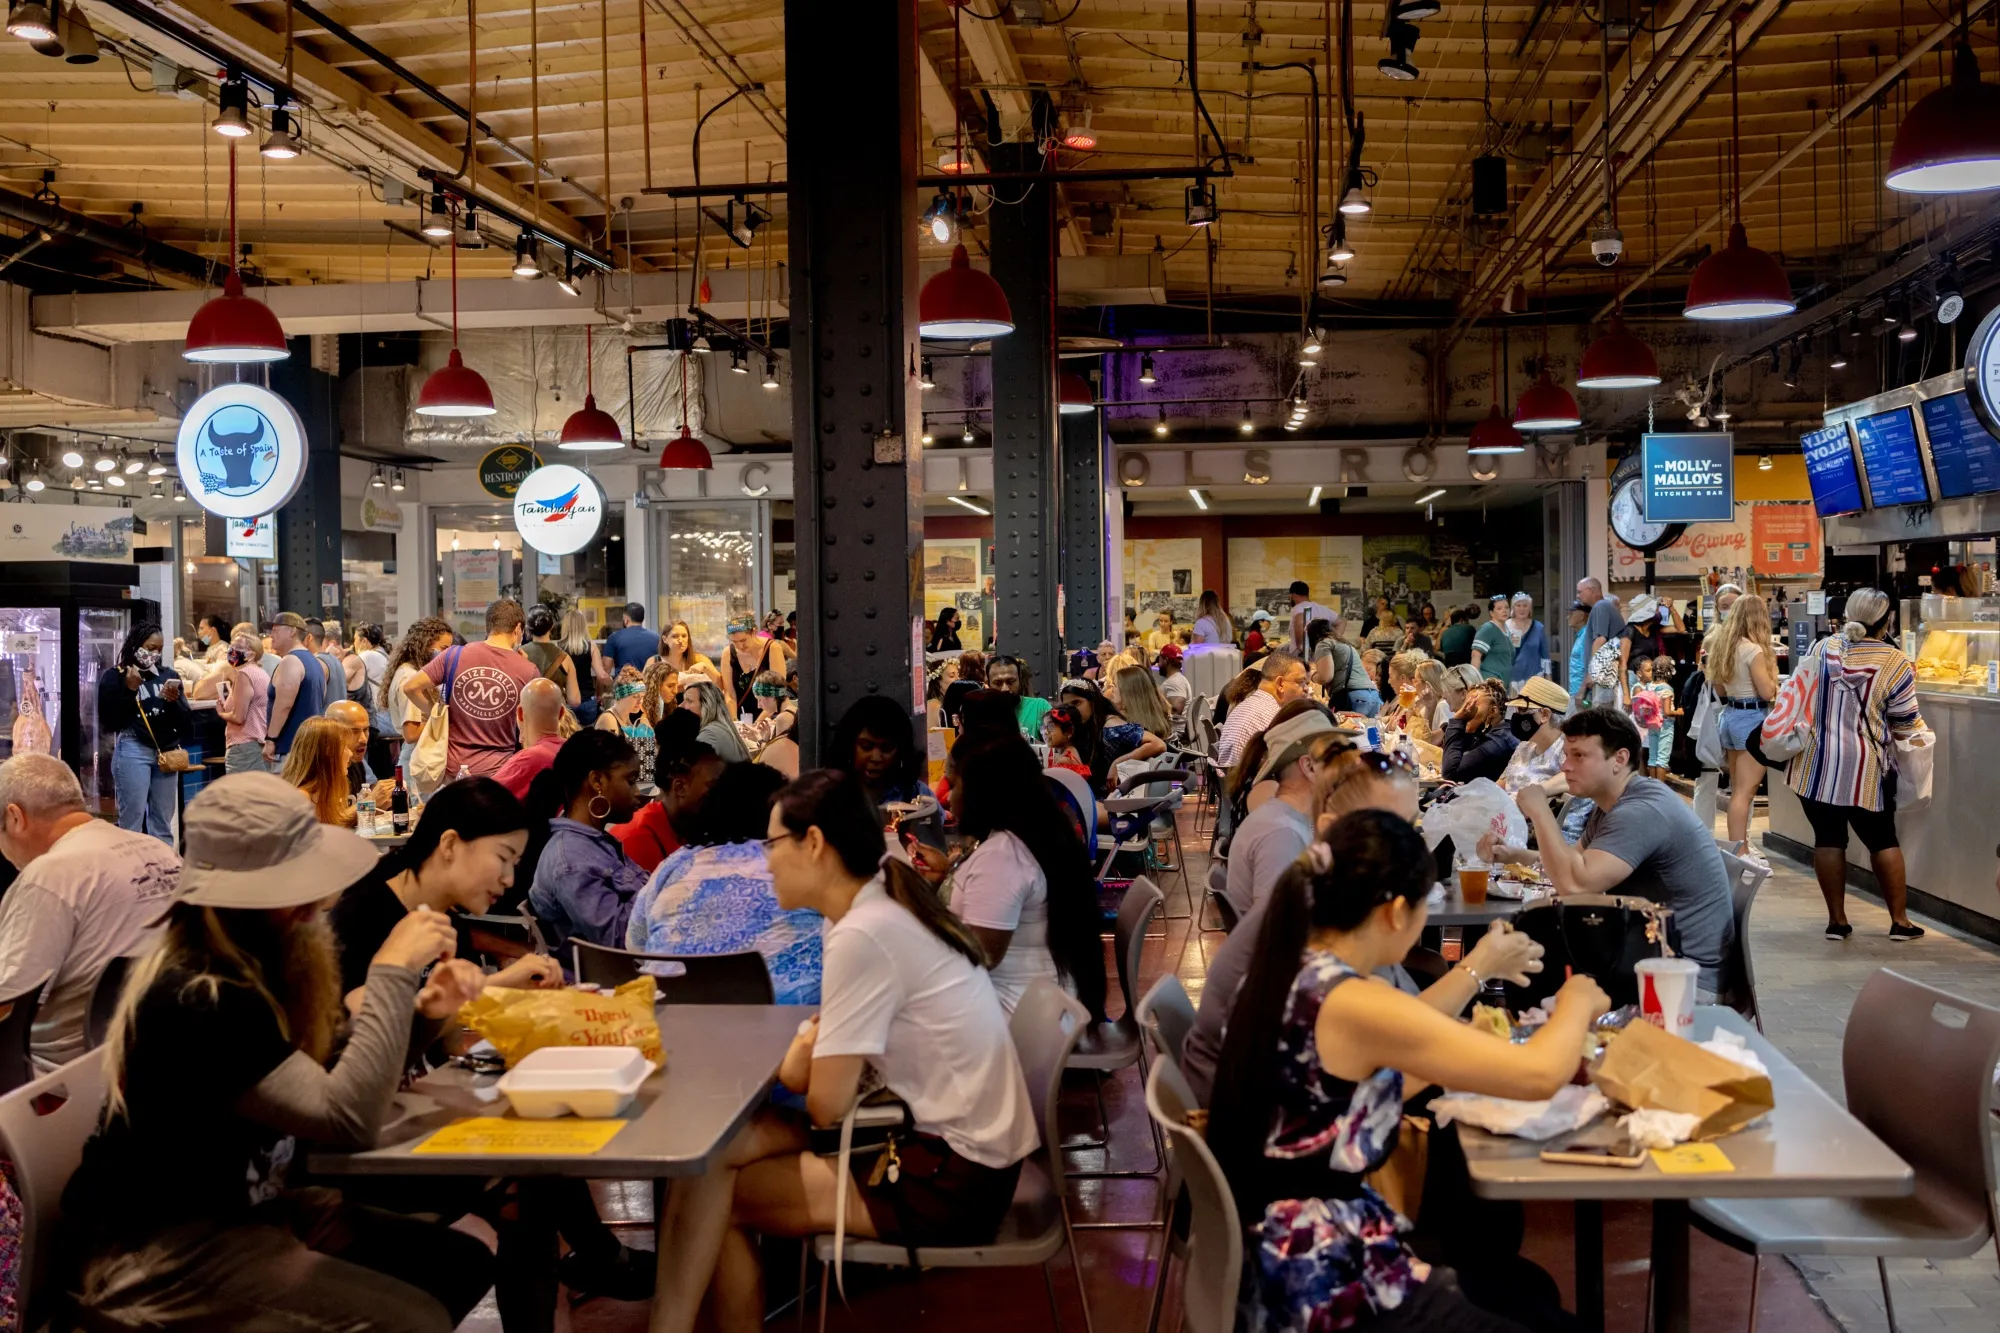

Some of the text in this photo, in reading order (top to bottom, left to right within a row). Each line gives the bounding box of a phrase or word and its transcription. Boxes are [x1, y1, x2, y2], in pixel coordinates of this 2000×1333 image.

[200, 442, 274, 458] A Taste of Spain
[1340, 444, 1571, 483] ROOM
[1664, 459, 1712, 472] MOLLY
[637, 461, 770, 497] RIC
[1654, 472, 1723, 486] MALLOY'S
[517, 502, 597, 519] Tambayan
[1641, 531, 1647, 541] 6
[1689, 532, 1746, 558] Giving
[455, 669, 515, 702] MAIZE VALLEY
